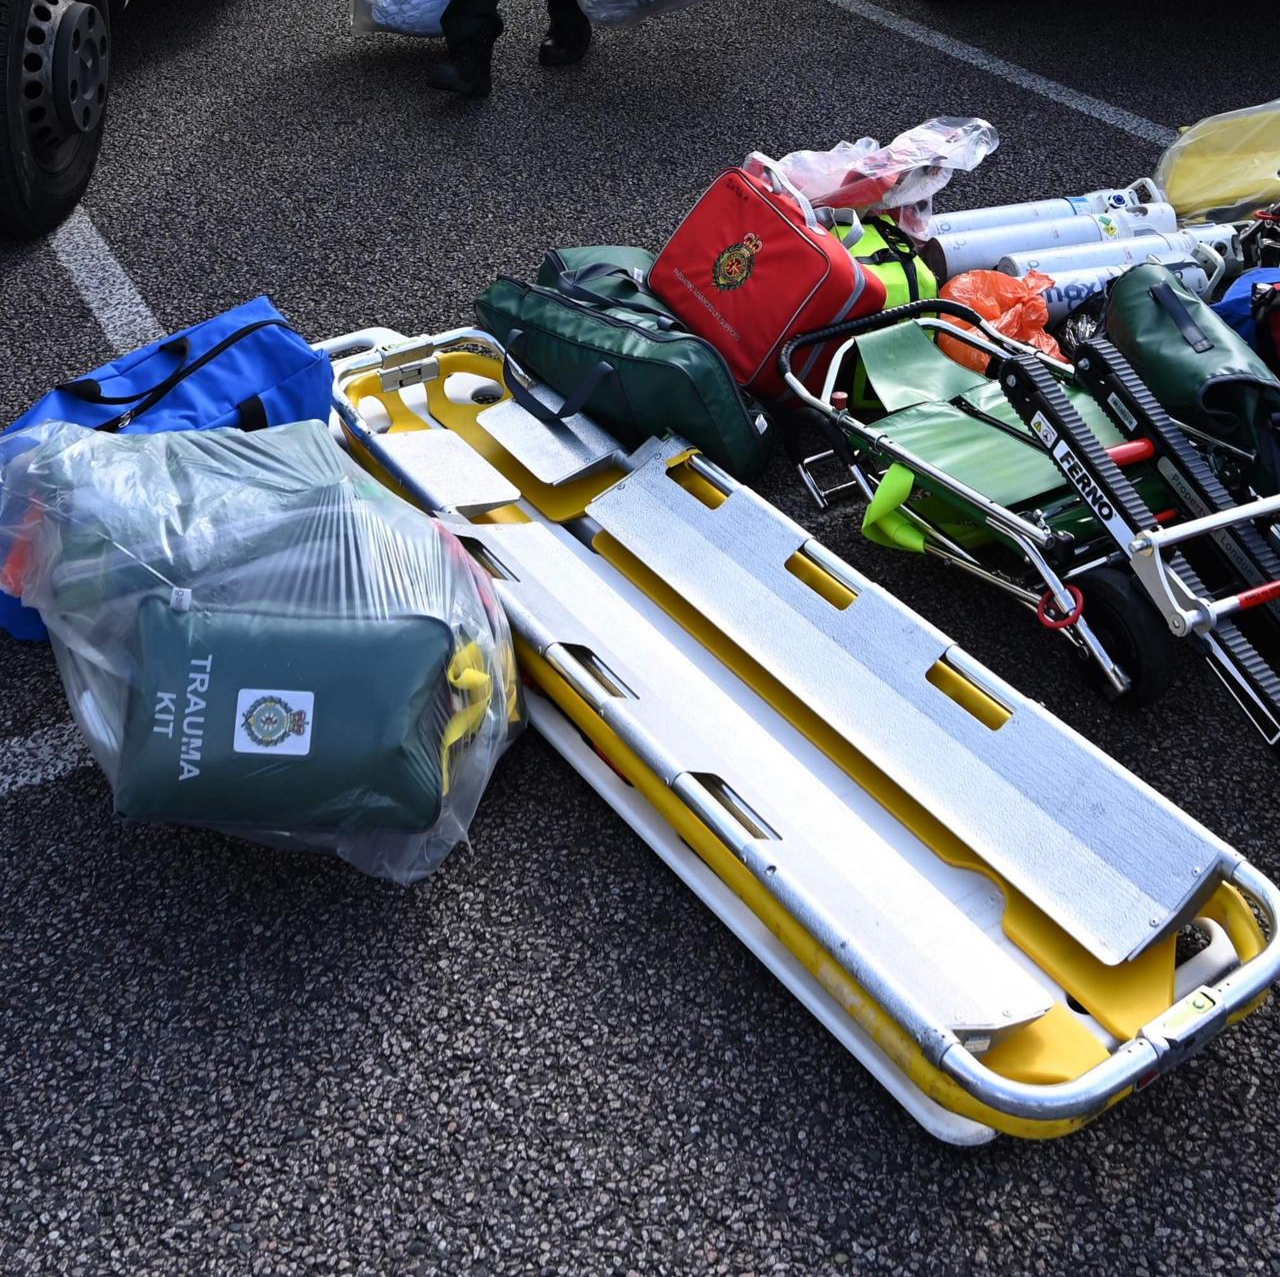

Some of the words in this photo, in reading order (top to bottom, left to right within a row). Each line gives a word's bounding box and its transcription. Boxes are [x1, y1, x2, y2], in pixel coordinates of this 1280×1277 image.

[1060, 450, 1114, 521] FERNO
[1220, 534, 1255, 579] London
[153, 691, 177, 740] KIT
[178, 654, 214, 782] TRAUMA
